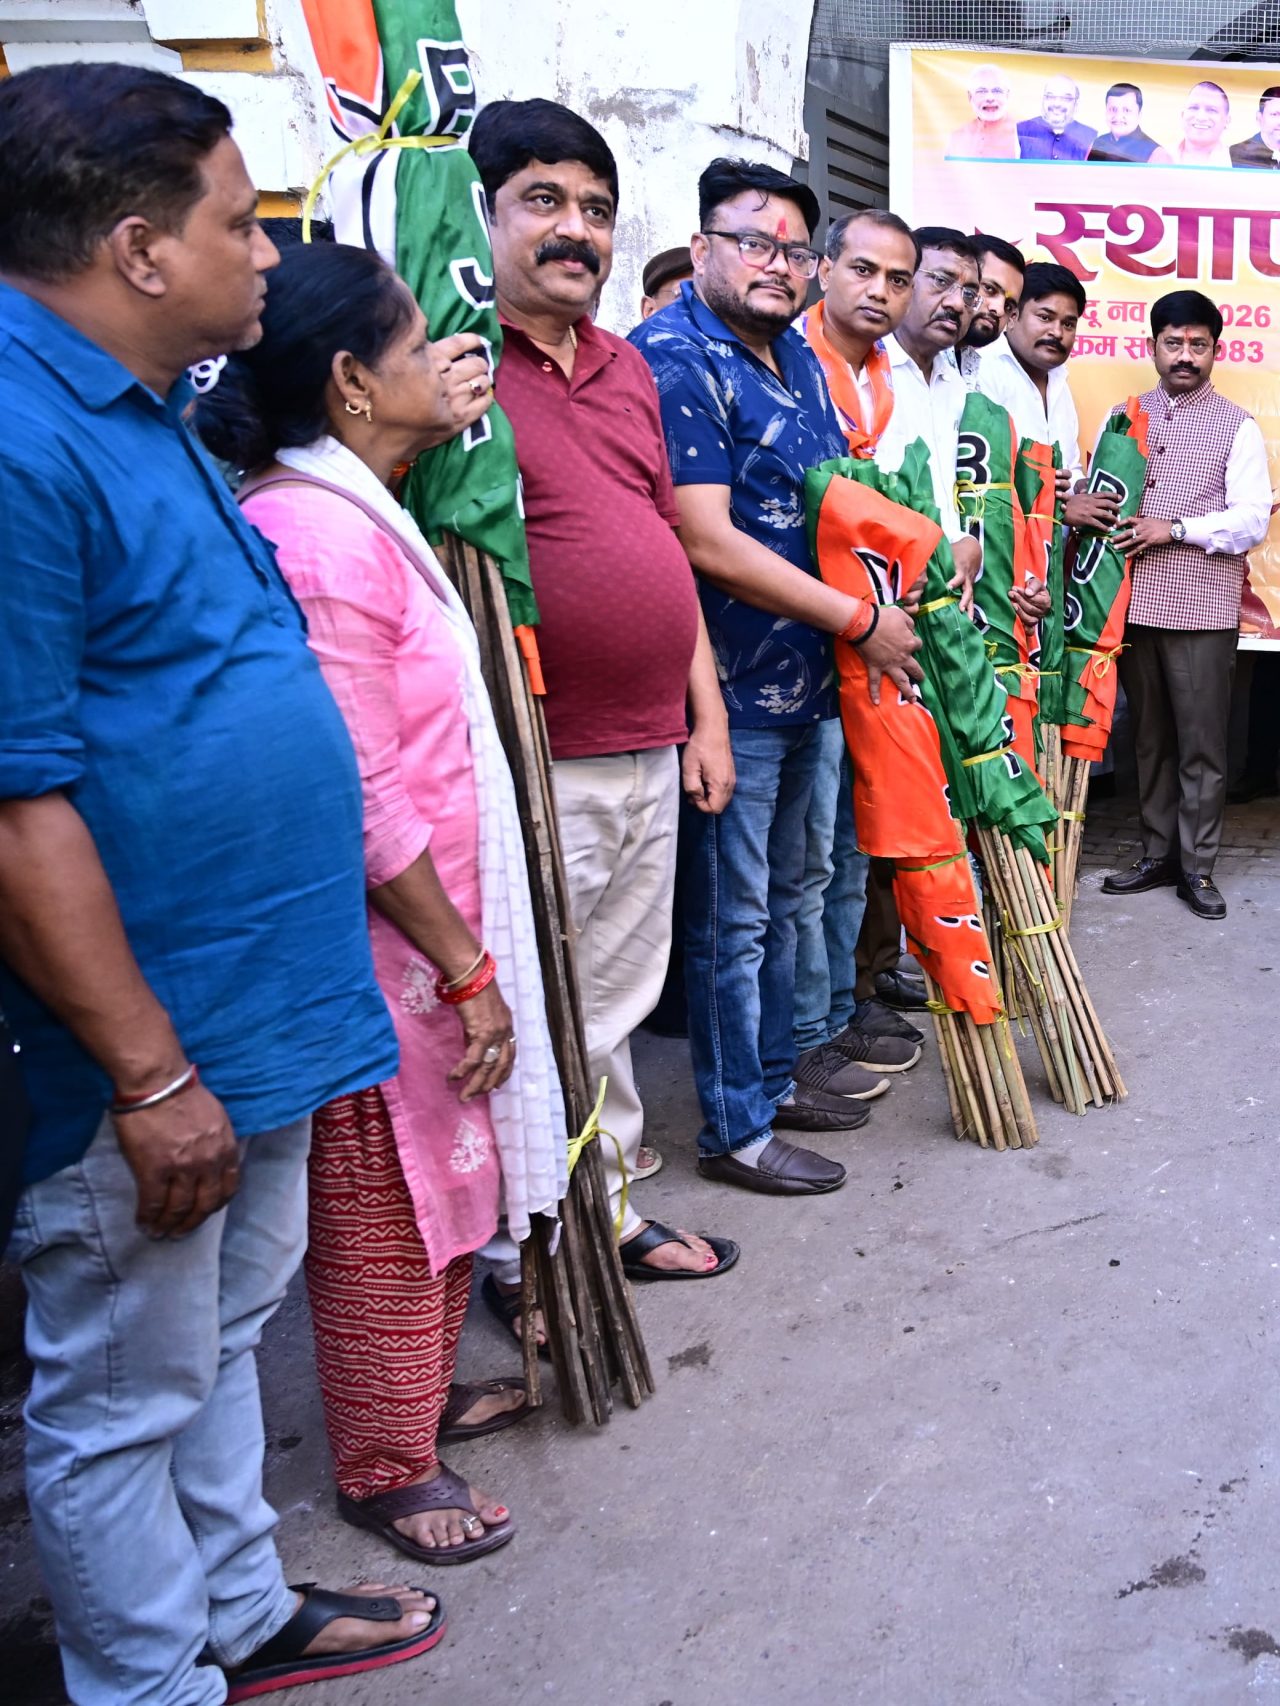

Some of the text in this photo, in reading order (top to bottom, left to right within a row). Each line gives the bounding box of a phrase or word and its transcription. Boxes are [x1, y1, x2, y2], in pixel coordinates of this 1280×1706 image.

[1082, 299, 1102, 328] दू
[1217, 303, 1271, 328] 026
[1070, 334, 1118, 358] क्रम
[1215, 339, 1264, 363] 083
